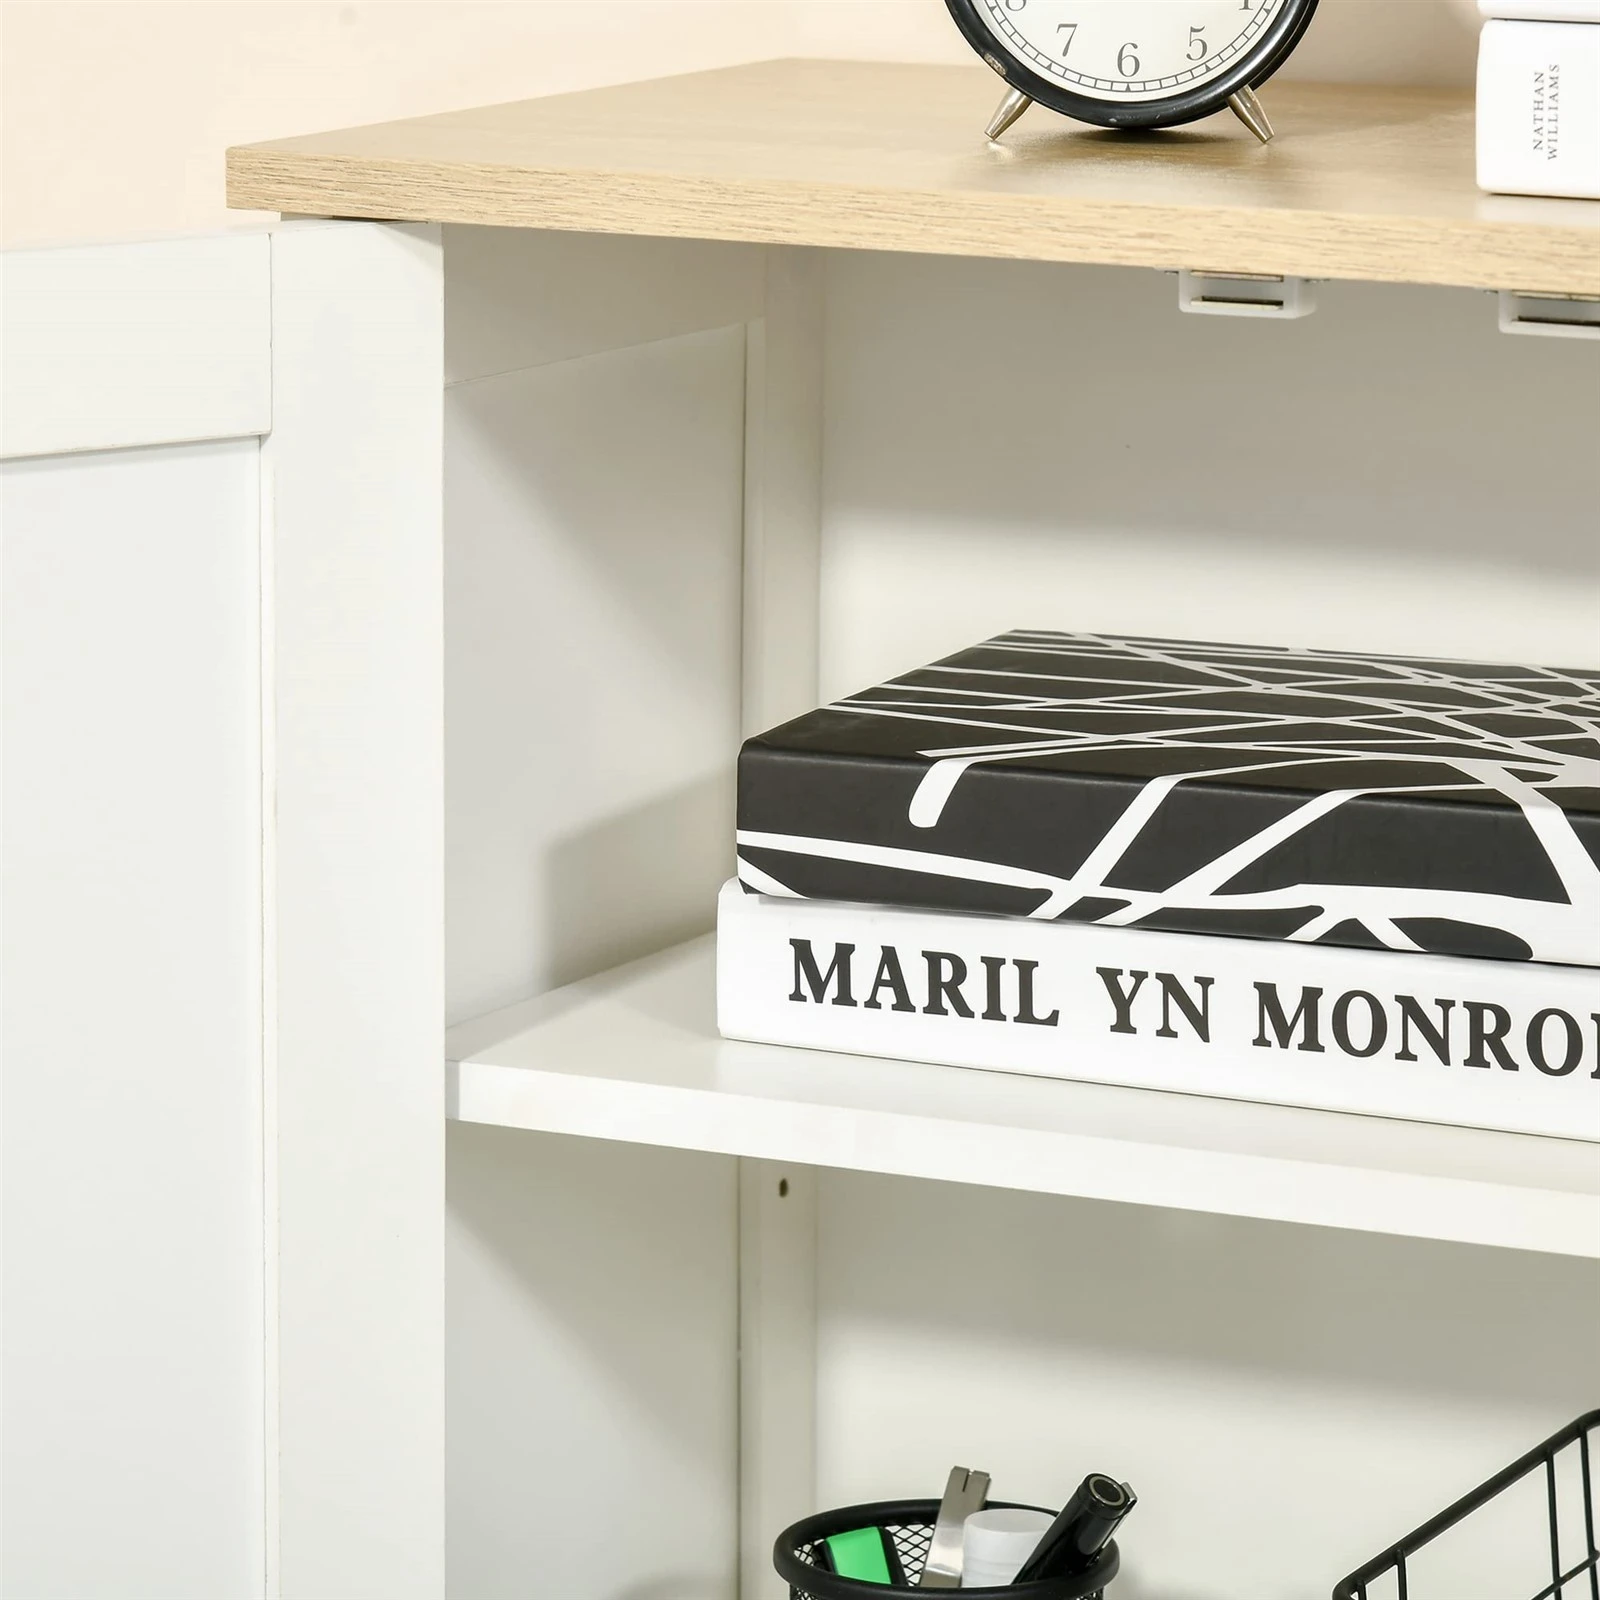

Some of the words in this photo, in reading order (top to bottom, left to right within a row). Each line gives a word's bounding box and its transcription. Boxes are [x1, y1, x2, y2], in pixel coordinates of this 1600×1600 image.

[1056, 23, 1078, 57] 7
[1185, 25, 1208, 61] 5
[1117, 42, 1141, 78] 6
[1532, 71, 1545, 151] NATHAN
[1547, 63, 1560, 161] WILLIAMS
